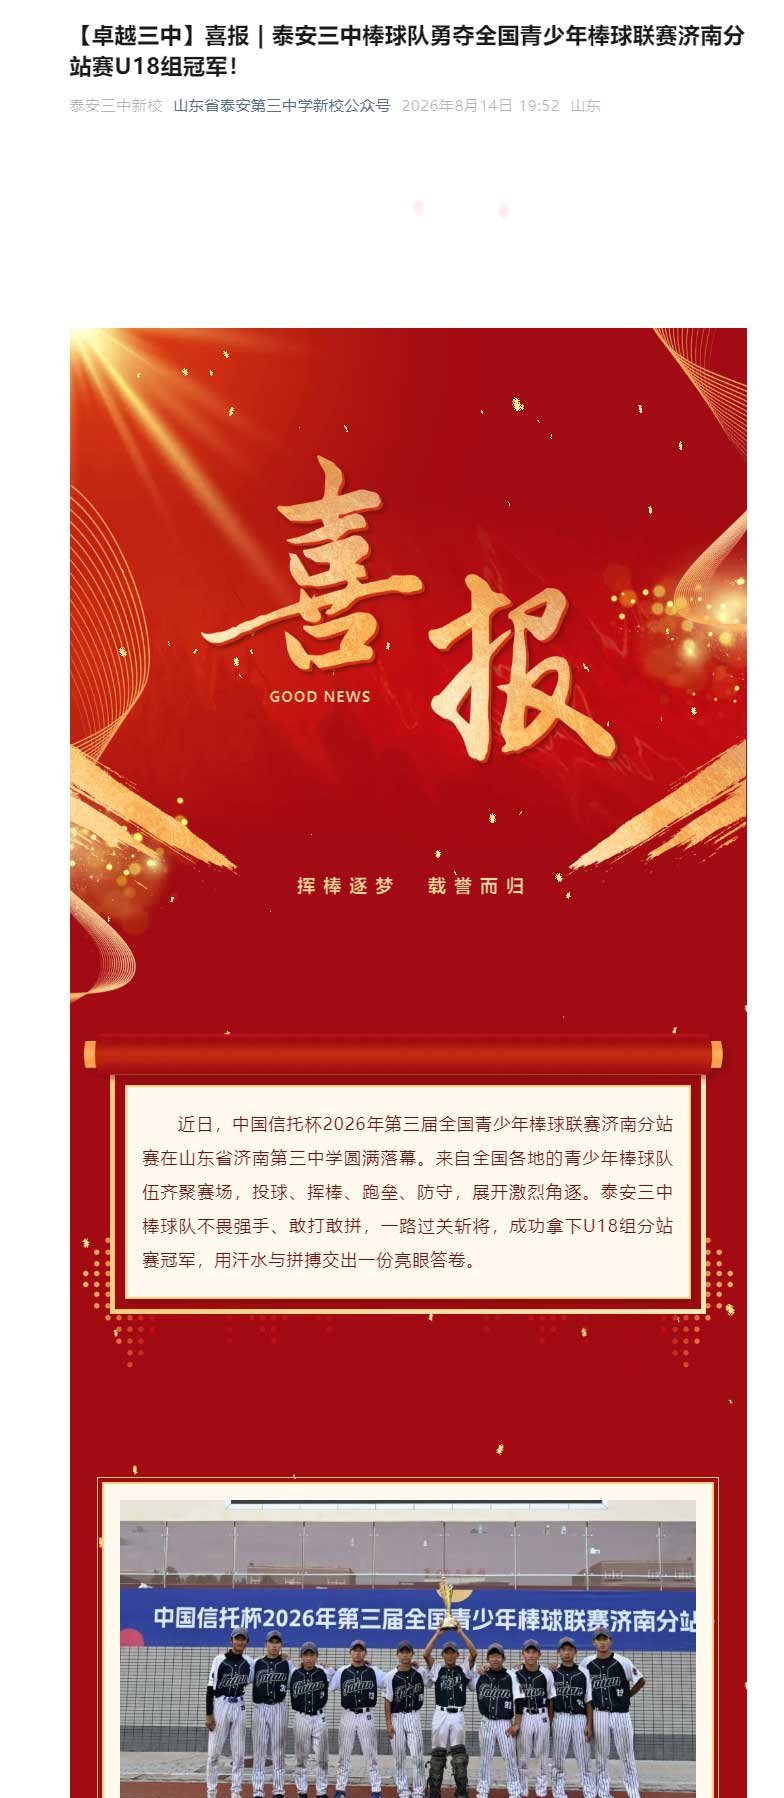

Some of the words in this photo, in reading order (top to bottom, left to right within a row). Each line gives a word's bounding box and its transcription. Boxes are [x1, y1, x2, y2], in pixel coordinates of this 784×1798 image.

[70, 98, 162, 112] 泰安三中新校
[175, 98, 391, 112] 山东省泰安第三中学新校公众号
[403, 99, 511, 112] 2026年8月14日
[520, 100, 559, 111] 19:52
[572, 99, 600, 112] 山东
[201, 455, 617, 763] 喜报
[270, 691, 317, 702] GOOD
[325, 691, 369, 702] NEWS
[298, 877, 392, 894] 挥棒逐梦
[428, 877, 523, 894] 载誉而归
[178, 1115, 673, 1133] 近日，中国信托杯2026年第三届全国青少年棒球联赛济南分站
[142, 1149, 673, 1166] 赛在山东省济南第三中学圆满落幕。来自全国各地的青少年棒球队
[142, 1183, 672, 1200] 伍齐聚赛场，投球、挥棒、跑垒、防守，展开激烈角逐。泰安三中
[142, 1217, 673, 1234] 棒球队不畏强手、敢打敢拼，一路过关斩将，成功拿下U18组分站
[142, 1251, 472, 1268] 赛冠军，用汗水与拼搏交出一份亮眼答卷。
